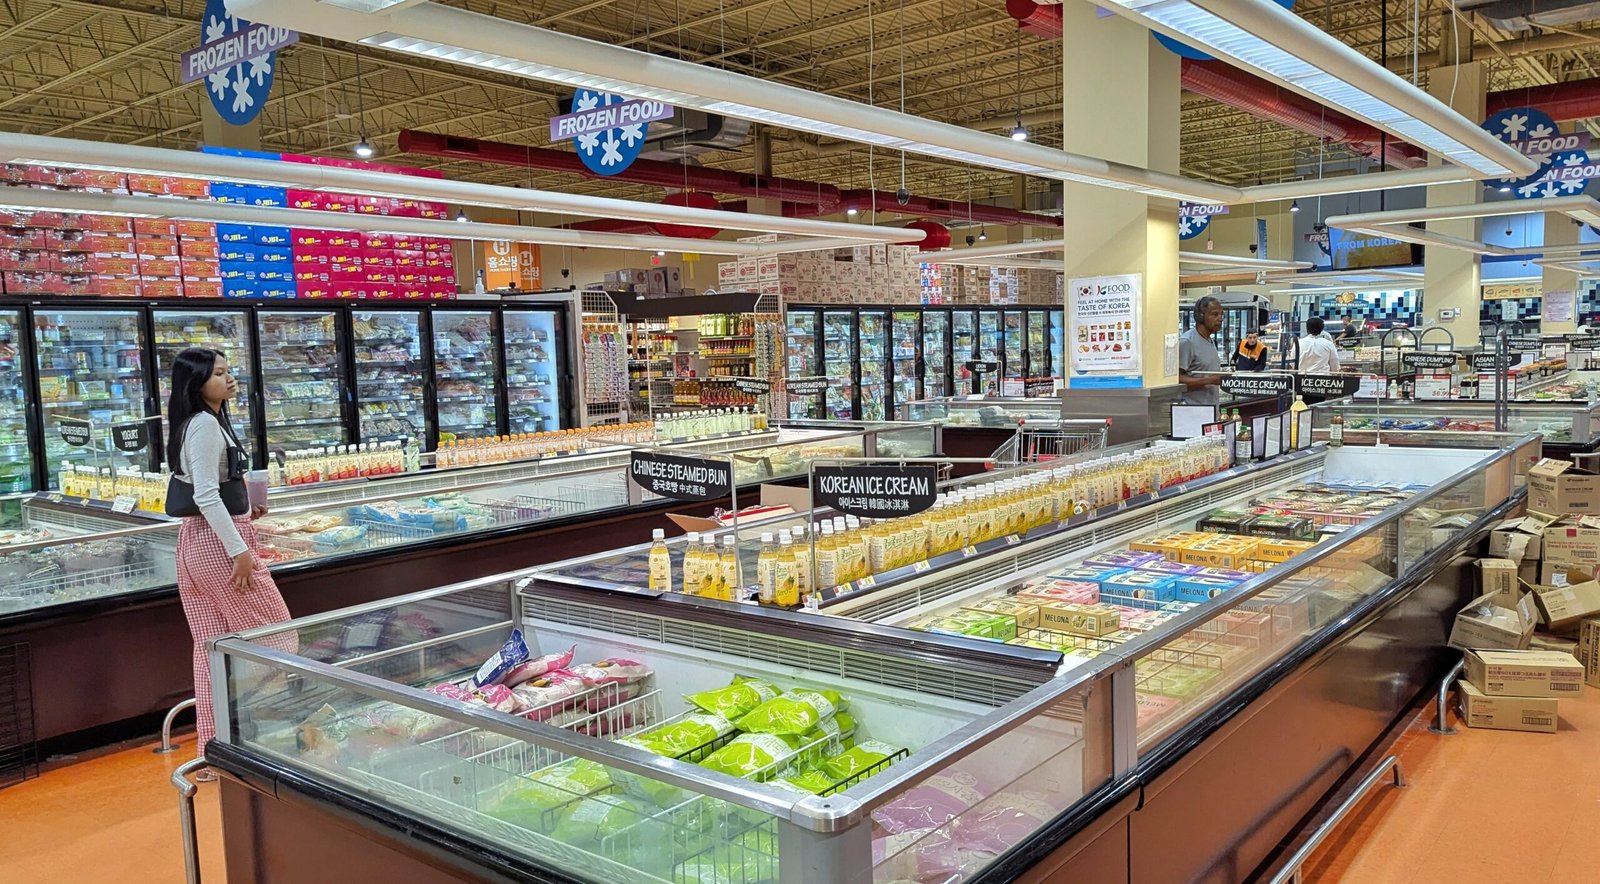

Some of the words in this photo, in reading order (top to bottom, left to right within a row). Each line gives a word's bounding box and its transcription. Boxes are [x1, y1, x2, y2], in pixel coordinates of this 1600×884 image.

[189, 34, 245, 76] FROZEN
[247, 25, 289, 55] FOOD
[558, 107, 617, 137] FROZEN
[620, 101, 664, 123] FOOD
[1526, 136, 1579, 153] FOOD
[1192, 205, 1223, 215] FOOD
[1337, 240, 1364, 249] FROM
[1367, 238, 1402, 248] KOREA
[1108, 284, 1130, 292] FOOD
[1404, 355, 1426, 363] CHINESE
[1427, 356, 1454, 364] DUMPLING
[1222, 379, 1246, 388] MOCHI
[1246, 380, 1258, 389] ICE
[1258, 381, 1287, 390] CREAM
[1301, 378, 1314, 387] ICE
[1314, 379, 1344, 389] CREAM
[121, 429, 138, 440] YOGURT
[633, 459, 667, 478] CHINESE
[667, 463, 708, 483] STEAMED
[708, 469, 727, 486] BUN
[652, 479, 678, 493] 중국호빵
[680, 483, 706, 496] 中式蒸包
[820, 475, 865, 494] KOREAN
[865, 476, 884, 495] ICE
[885, 476, 929, 496] CREAM
[838, 497, 868, 510] 아이스크림
[869, 498, 910, 511] 韓國冰淇淋
[1185, 554, 1208, 562] MELONA
[1262, 549, 1285, 557] MELONA
[1106, 588, 1130, 597] MELONA
[1181, 587, 1205, 596] MELONA
[1044, 613, 1070, 624] MELONA
[1104, 619, 1117, 628] MELONA
